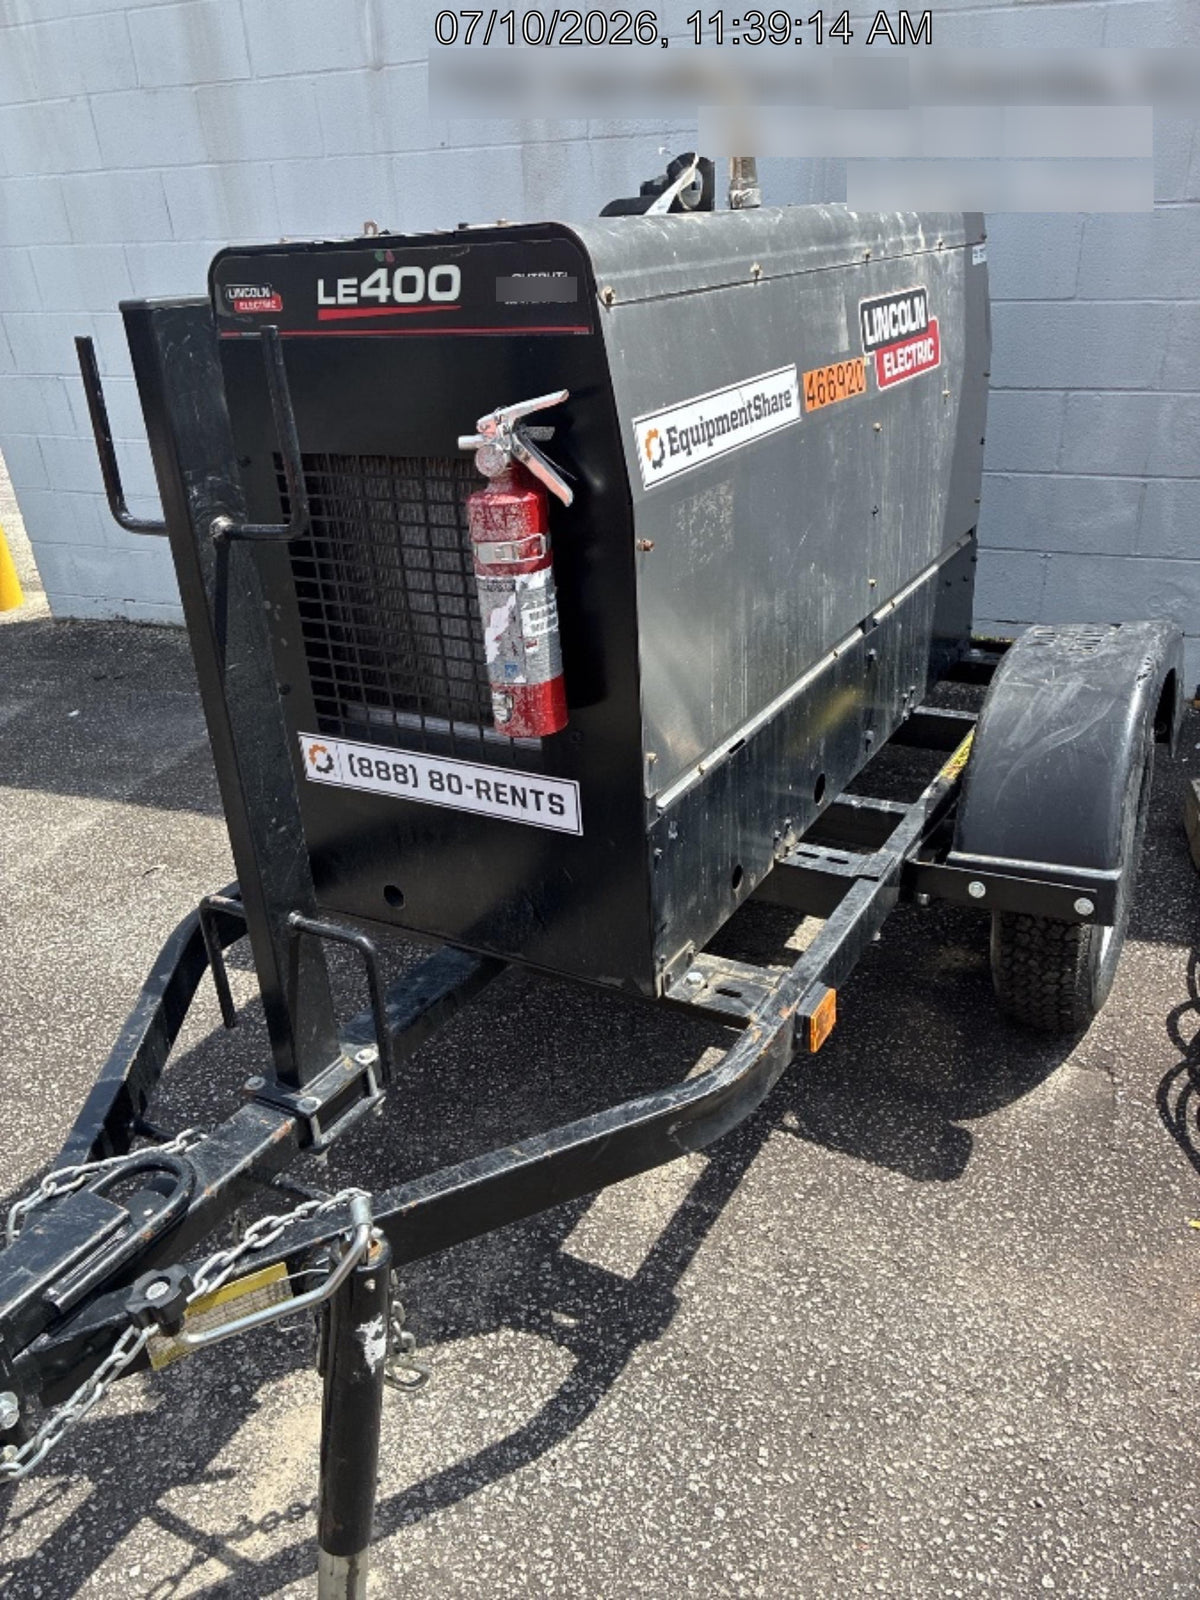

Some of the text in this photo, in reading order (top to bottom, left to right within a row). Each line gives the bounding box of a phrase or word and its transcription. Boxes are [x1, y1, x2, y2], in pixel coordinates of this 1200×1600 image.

[228, 287, 271, 299] LINCOLN
[239, 300, 276, 310] ELECTRIC
[317, 264, 461, 305] LE400
[863, 295, 926, 345] LINCOLN
[883, 338, 935, 378] ELECTRIC
[807, 360, 863, 407] 466920
[666, 389, 792, 457] EquipmentShare
[348, 754, 565, 816] (888) 80-RENTS
